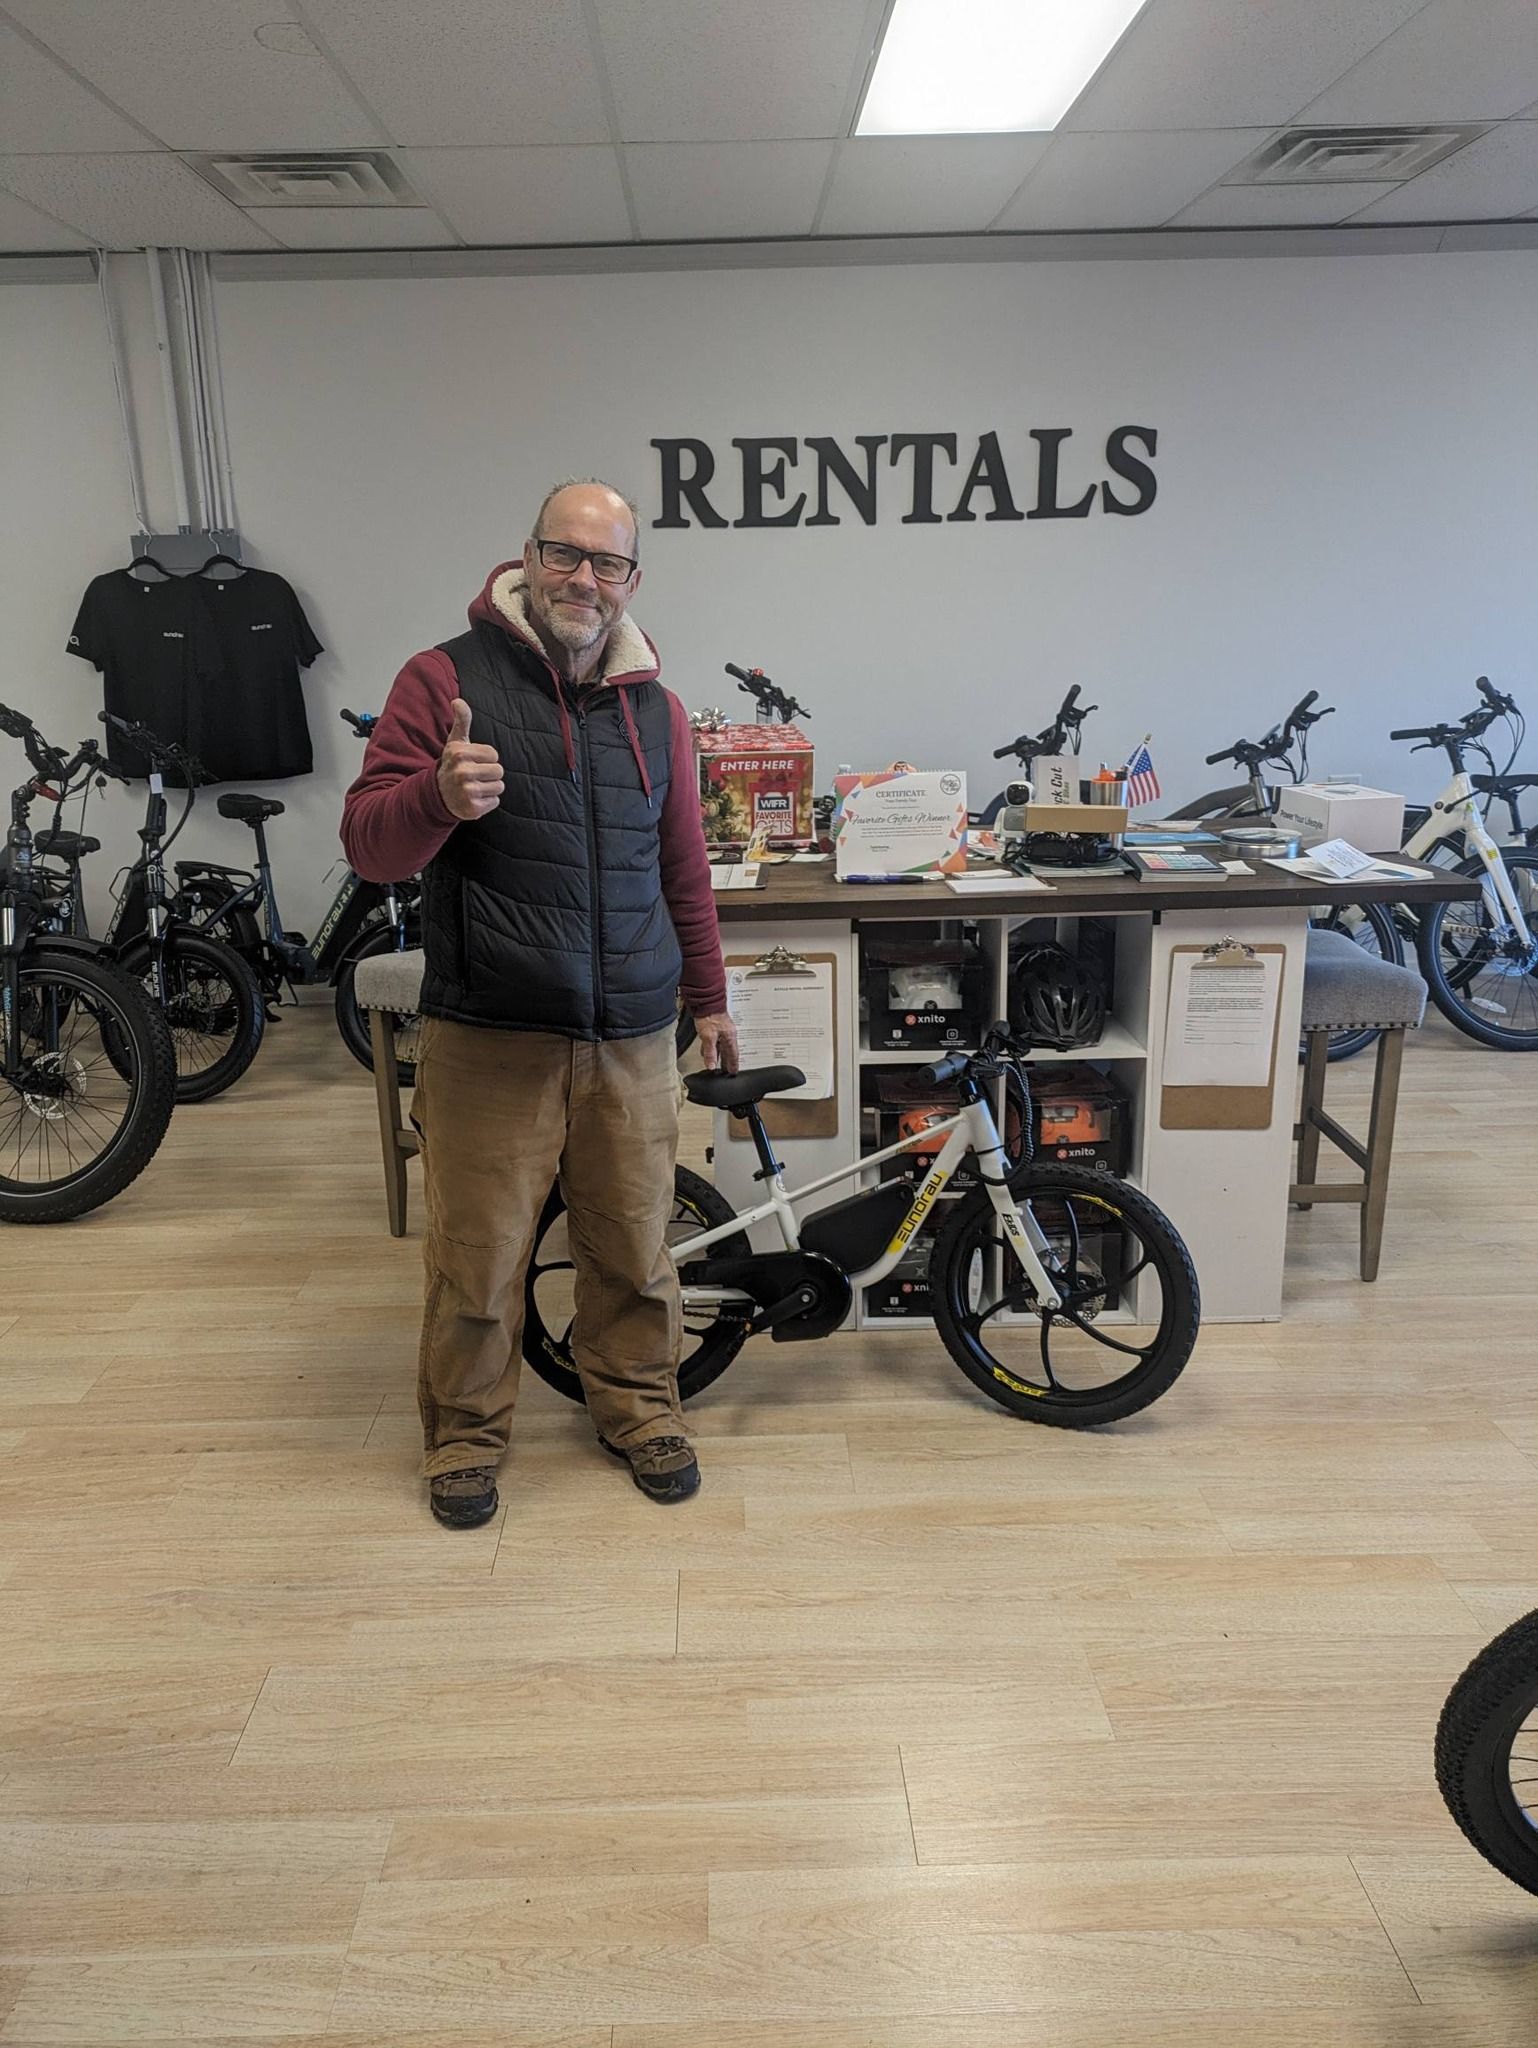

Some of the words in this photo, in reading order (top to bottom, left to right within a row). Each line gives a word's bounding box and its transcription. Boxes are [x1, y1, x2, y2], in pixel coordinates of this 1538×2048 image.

[650, 425, 1158, 529] RENTALS
[720, 761, 760, 771] ENTER
[762, 760, 794, 770] HERE
[1050, 767, 1063, 788] Cut
[875, 789, 927, 798] CERTIFICATE
[1050, 790, 1063, 804] ck
[759, 799, 788, 809] WIFR
[755, 811, 792, 820] FAVORITE
[852, 813, 885, 825] Favorite
[887, 813, 913, 825] Gifts
[915, 812, 950, 824] Winner
[917, 1014, 946, 1024] xnito
[1068, 1147, 1096, 1157] xnito
[913, 1282, 929, 1292] xni
